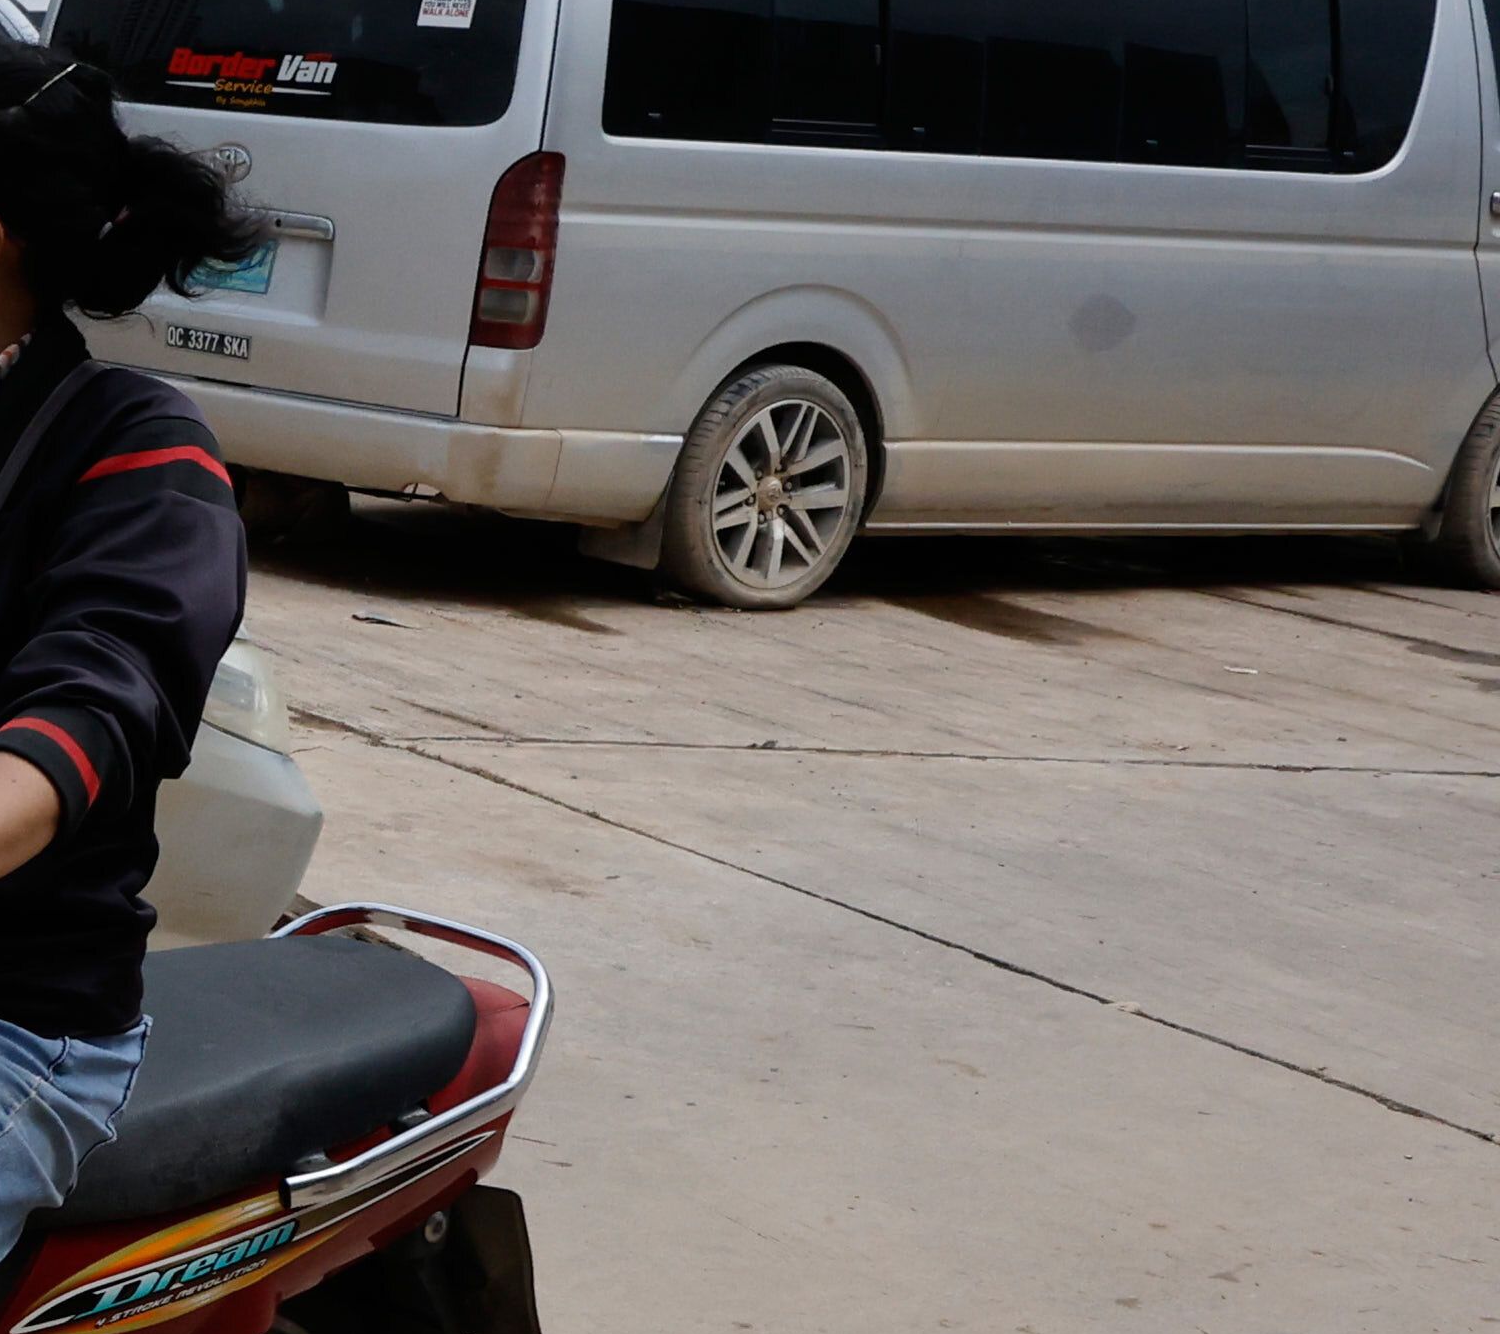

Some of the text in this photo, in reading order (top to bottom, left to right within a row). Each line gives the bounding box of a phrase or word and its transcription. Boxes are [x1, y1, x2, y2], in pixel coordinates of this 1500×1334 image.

[422, 7, 470, 18] WALK ALONE
[167, 46, 338, 84] Border Van
[213, 78, 273, 94] Service
[167, 326, 248, 357] QC 3377 SKA
[75, 1220, 297, 1318] Dream
[108, 1296, 174, 1324] STROKE
[175, 1257, 268, 1301] REVOLUTION
